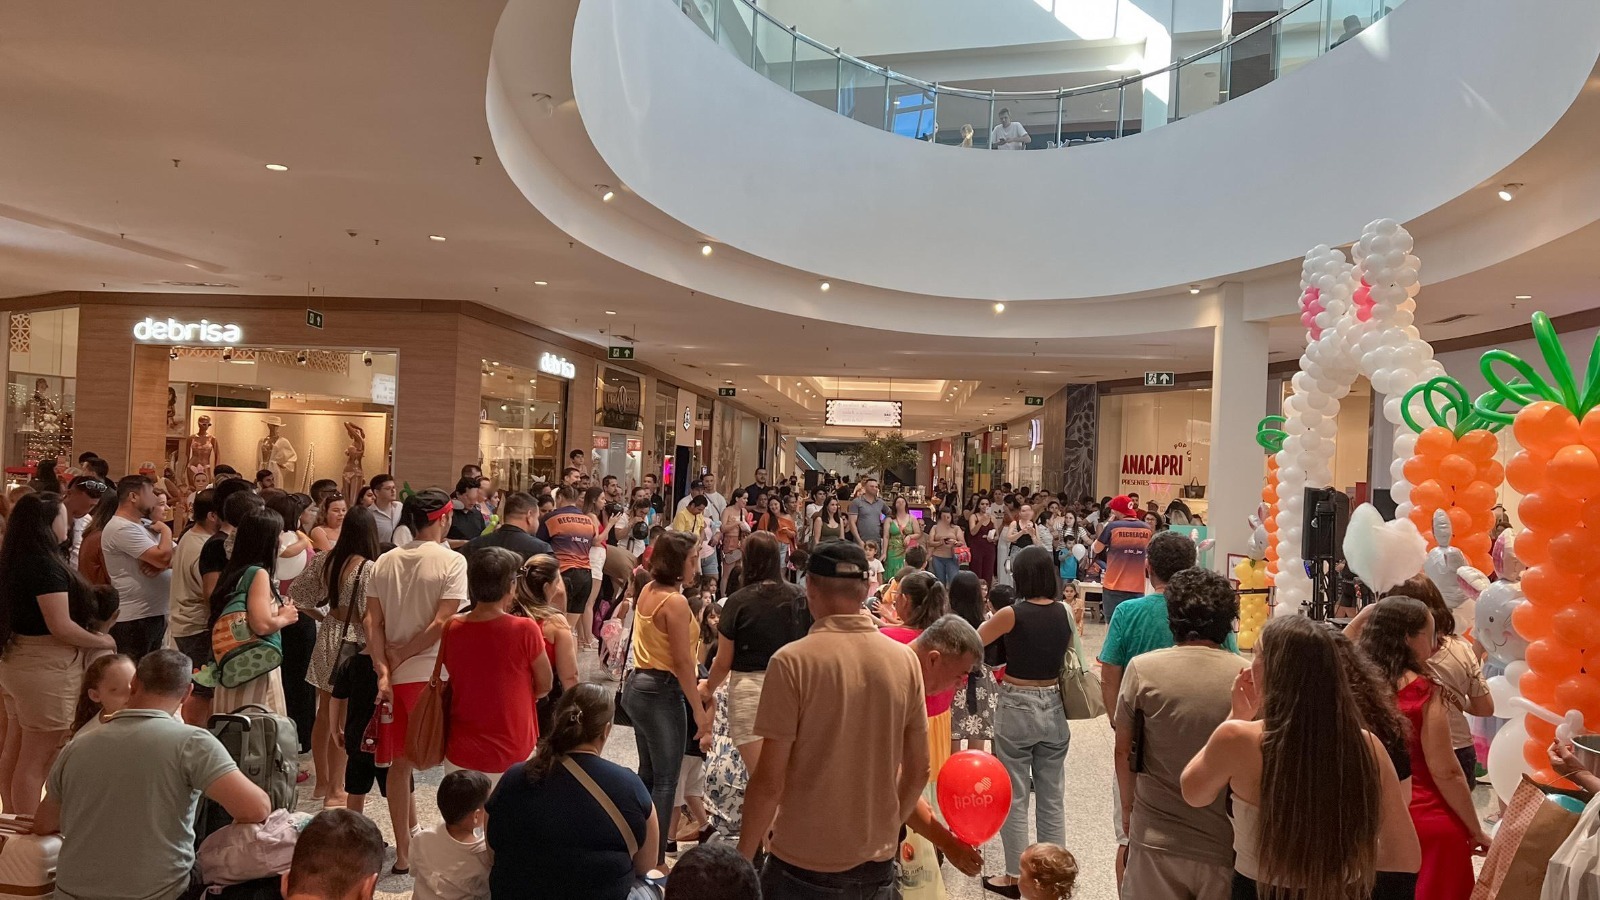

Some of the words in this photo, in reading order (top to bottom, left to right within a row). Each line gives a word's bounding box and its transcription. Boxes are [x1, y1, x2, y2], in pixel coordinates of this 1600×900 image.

[133, 316, 242, 343] debrisa
[1122, 454, 1183, 476] ANACAPRI
[1121, 479, 1150, 487] PRESENTES
